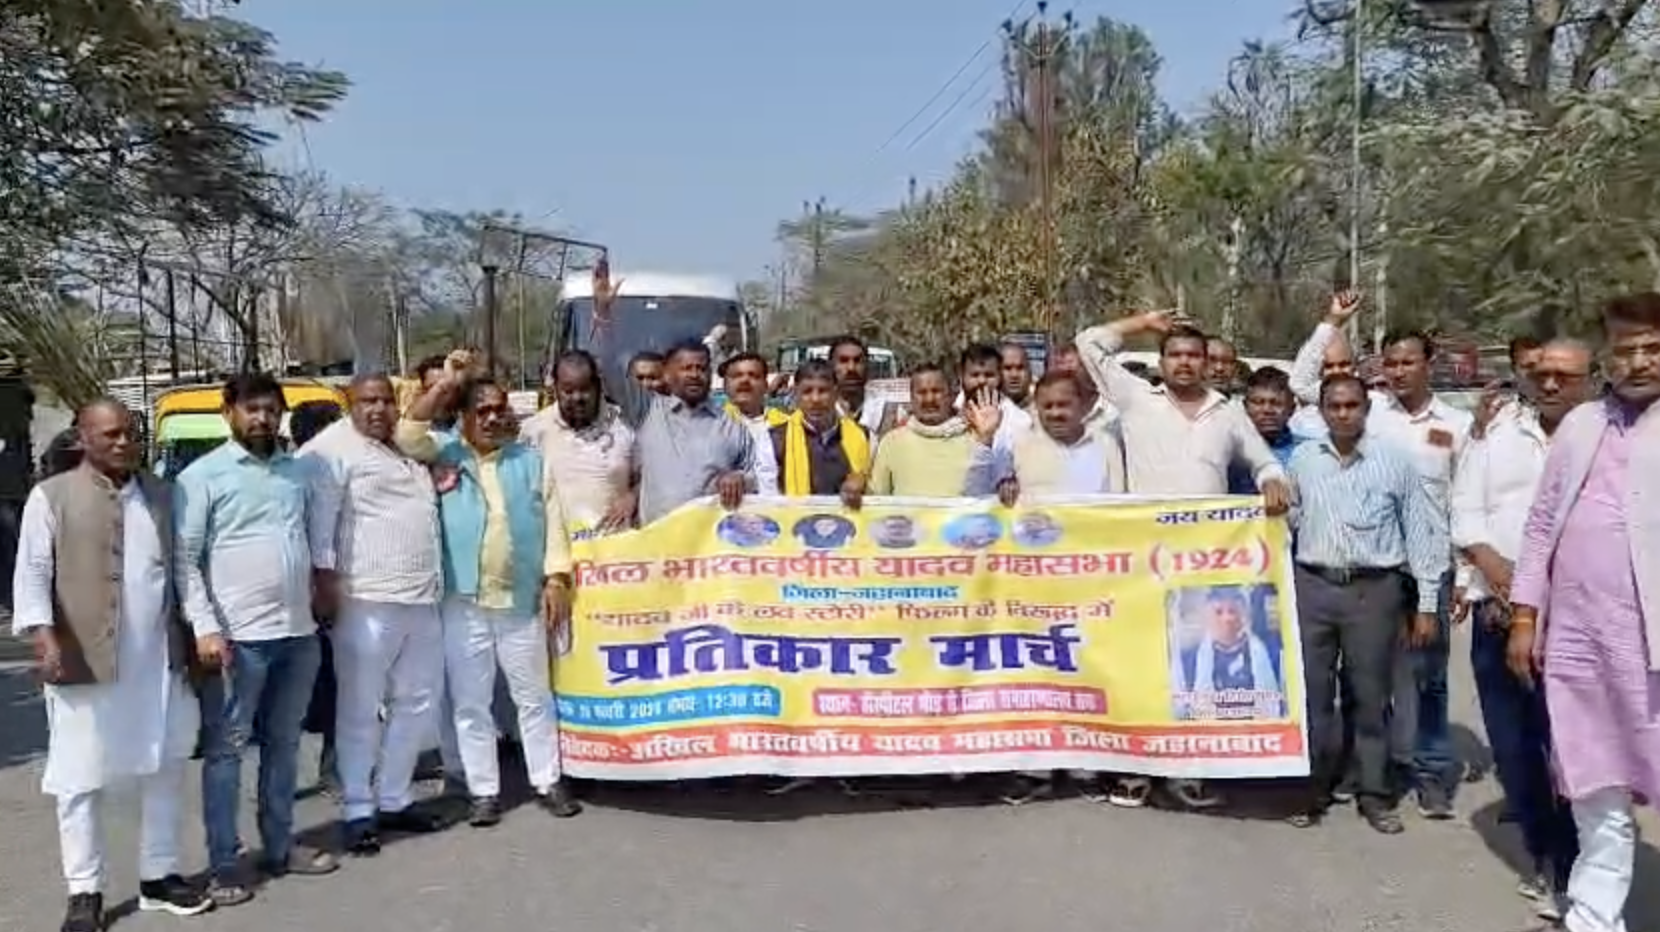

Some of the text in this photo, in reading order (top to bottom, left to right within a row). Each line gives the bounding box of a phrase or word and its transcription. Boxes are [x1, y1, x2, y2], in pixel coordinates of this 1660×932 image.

[573, 559, 654, 587] खिल
[873, 553, 977, 577] यादव
[986, 552, 1132, 576] महासभा
[597, 624, 1080, 685] प्रतिकार मार्च
[873, 733, 941, 752] यादव
[1063, 726, 1132, 751] जिला
[1142, 733, 1285, 754] जहानाबाद
